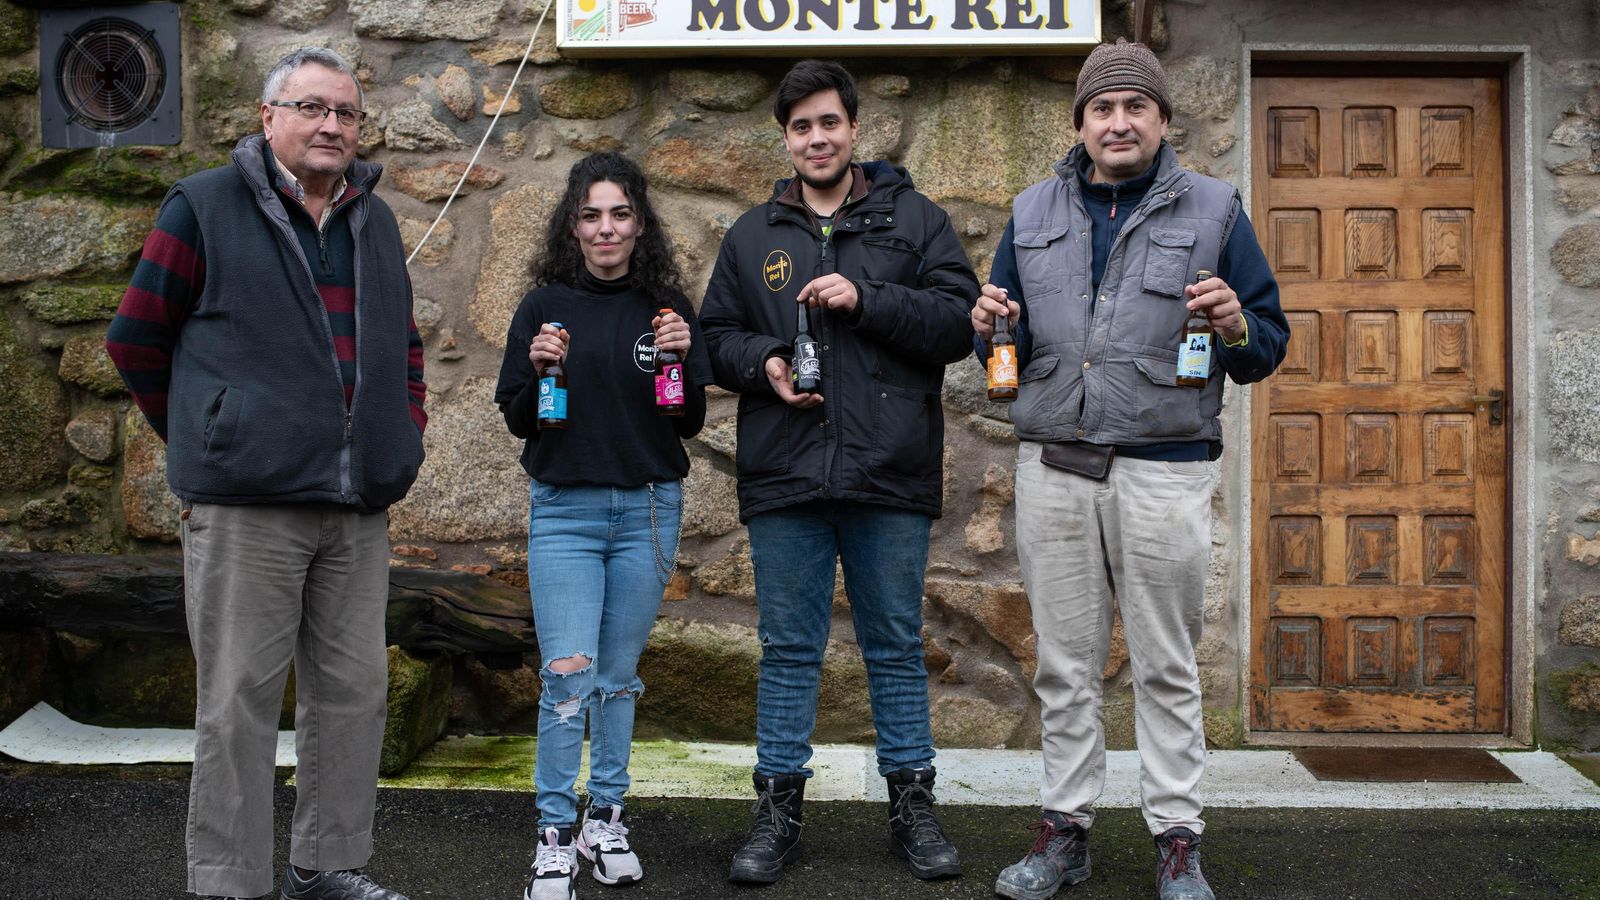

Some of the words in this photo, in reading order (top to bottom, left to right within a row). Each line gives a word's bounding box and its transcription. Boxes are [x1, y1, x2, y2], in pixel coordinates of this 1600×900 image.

[619, 3, 647, 14] BEER
[686, 0, 938, 31] MONTE
[950, 0, 1074, 31] REI
[766, 256, 788, 276] Monte
[769, 271, 780, 282] Rei
[639, 353, 652, 362] Rei
